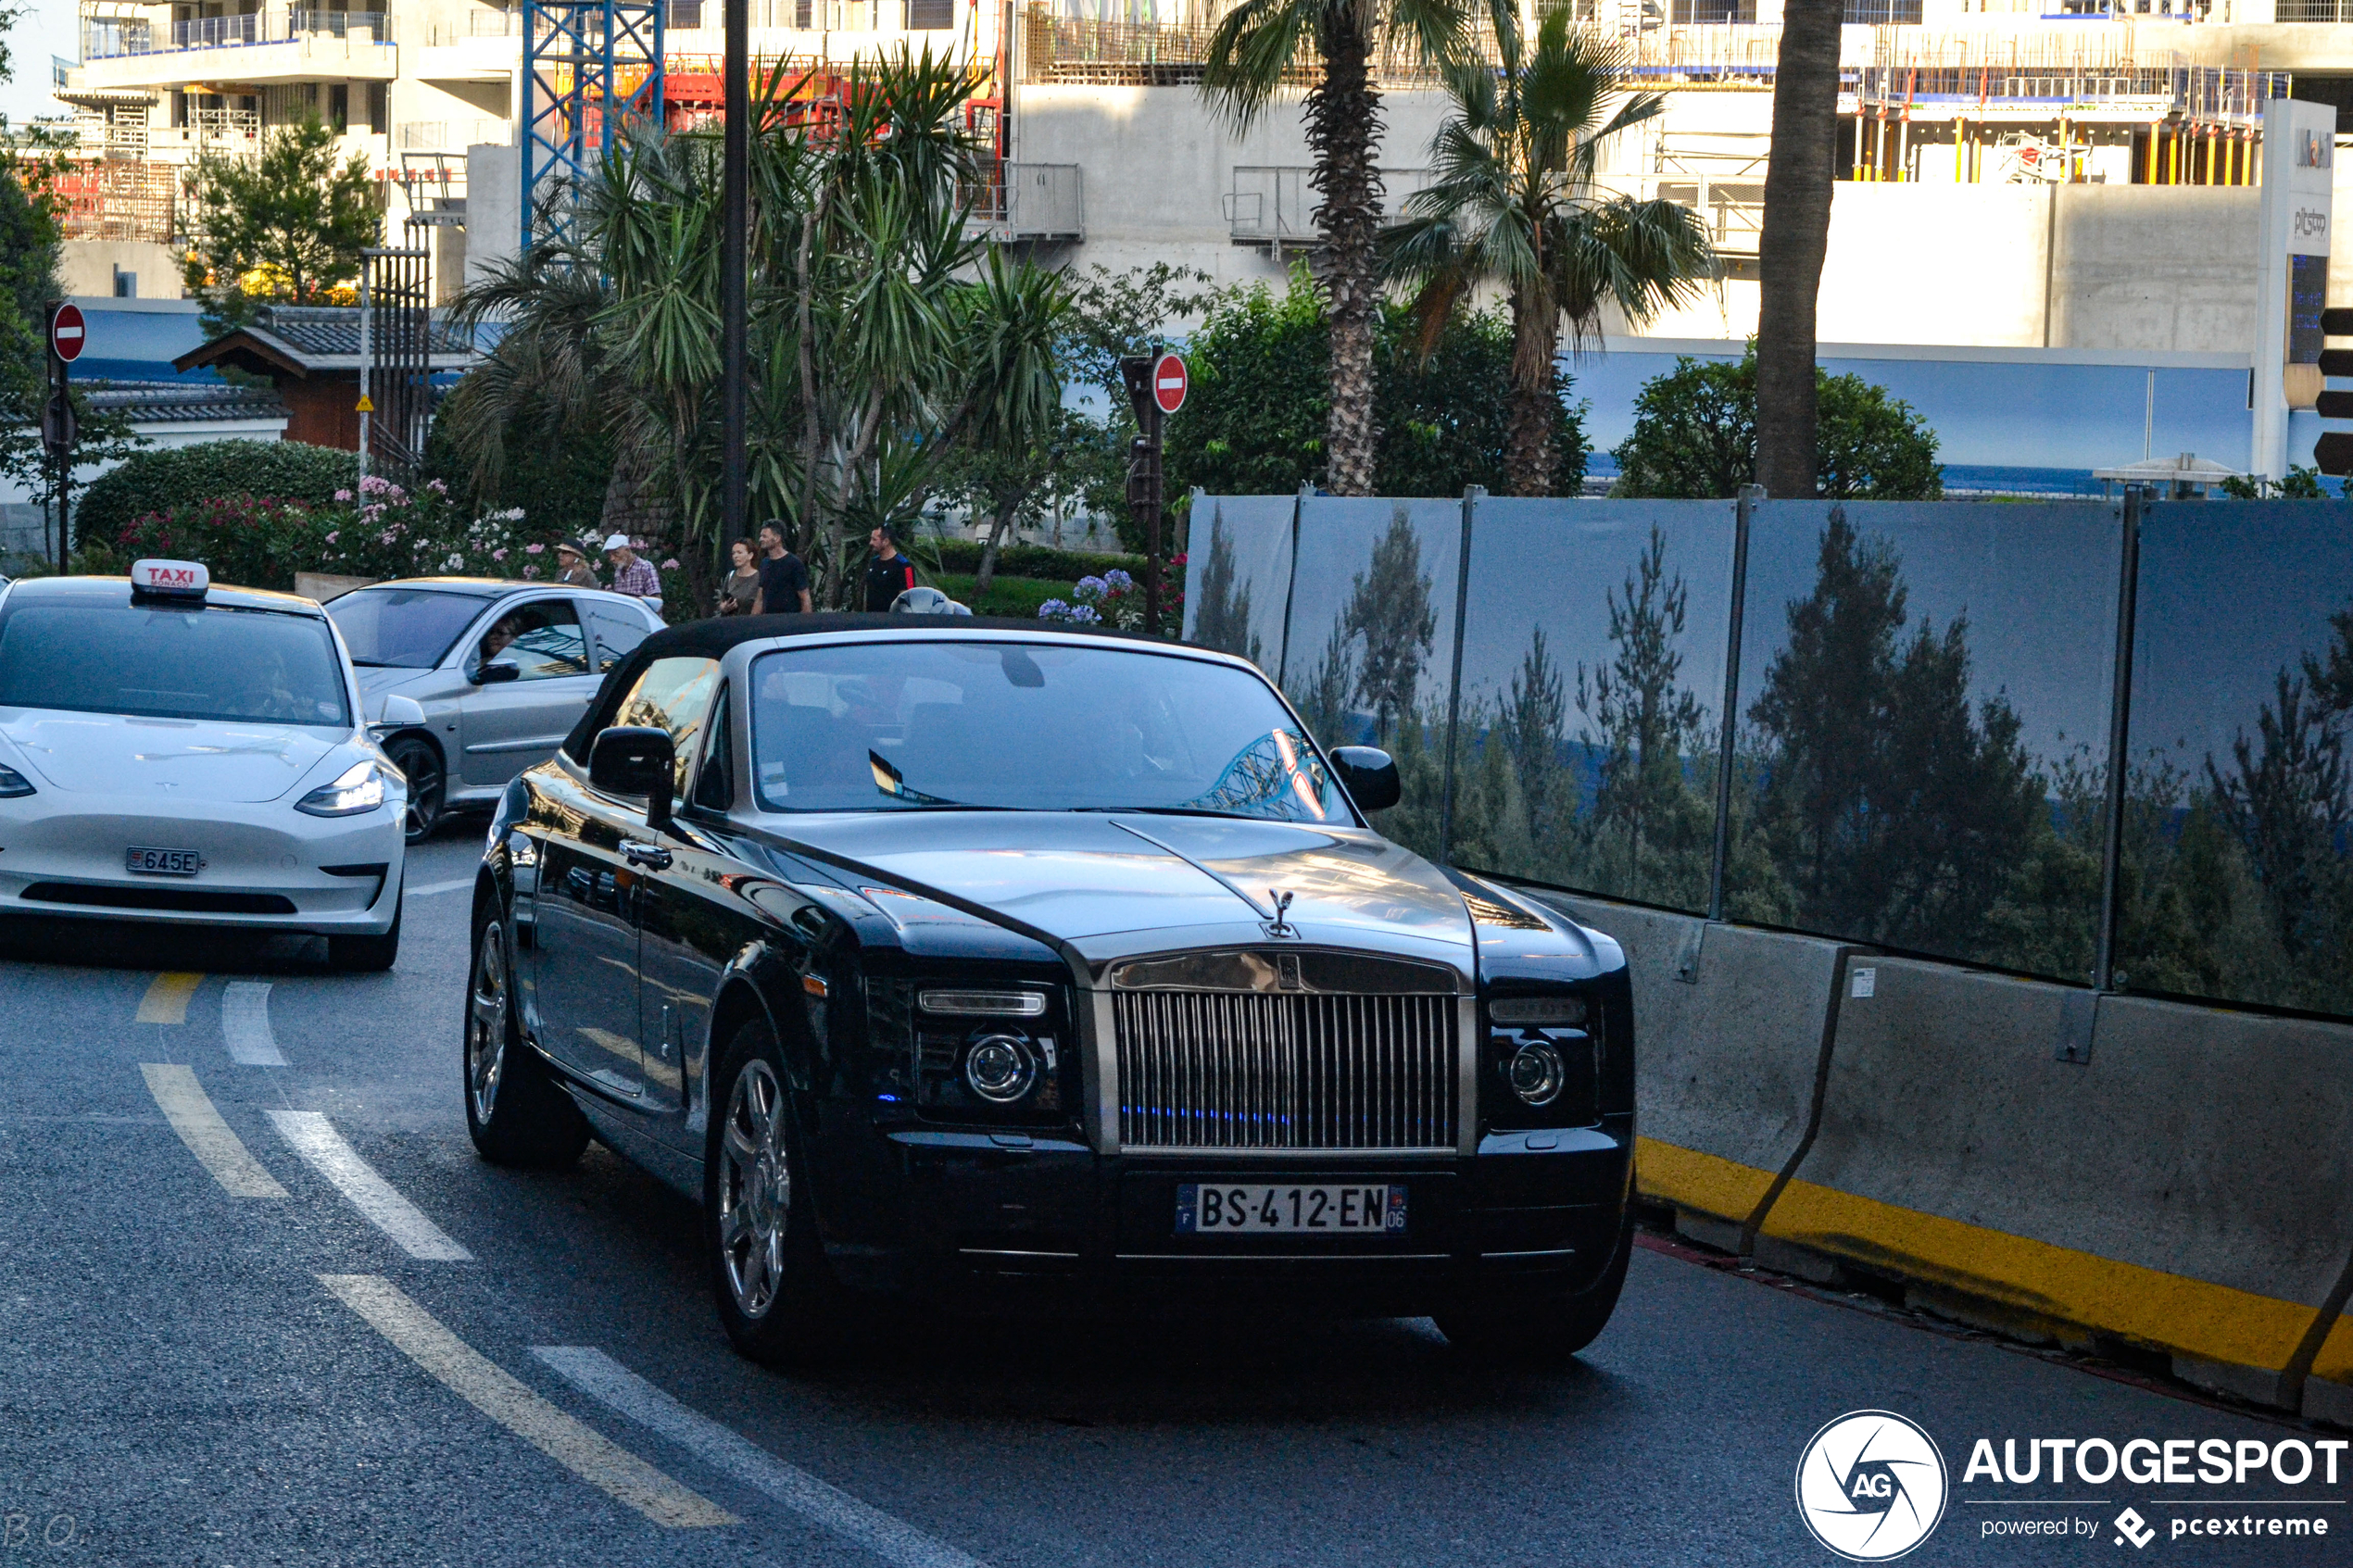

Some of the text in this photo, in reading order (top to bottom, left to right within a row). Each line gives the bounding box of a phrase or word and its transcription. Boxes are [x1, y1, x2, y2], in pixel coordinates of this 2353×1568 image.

[2295, 207, 2326, 236] pitstop
[148, 568, 195, 583] TAXI
[151, 579, 190, 588] MONACO
[145, 851, 195, 872] 645E
[1202, 1188, 1383, 1227] BS-412-EN
[1182, 1212, 1190, 1224] F
[1387, 1210, 1405, 1227] 06
